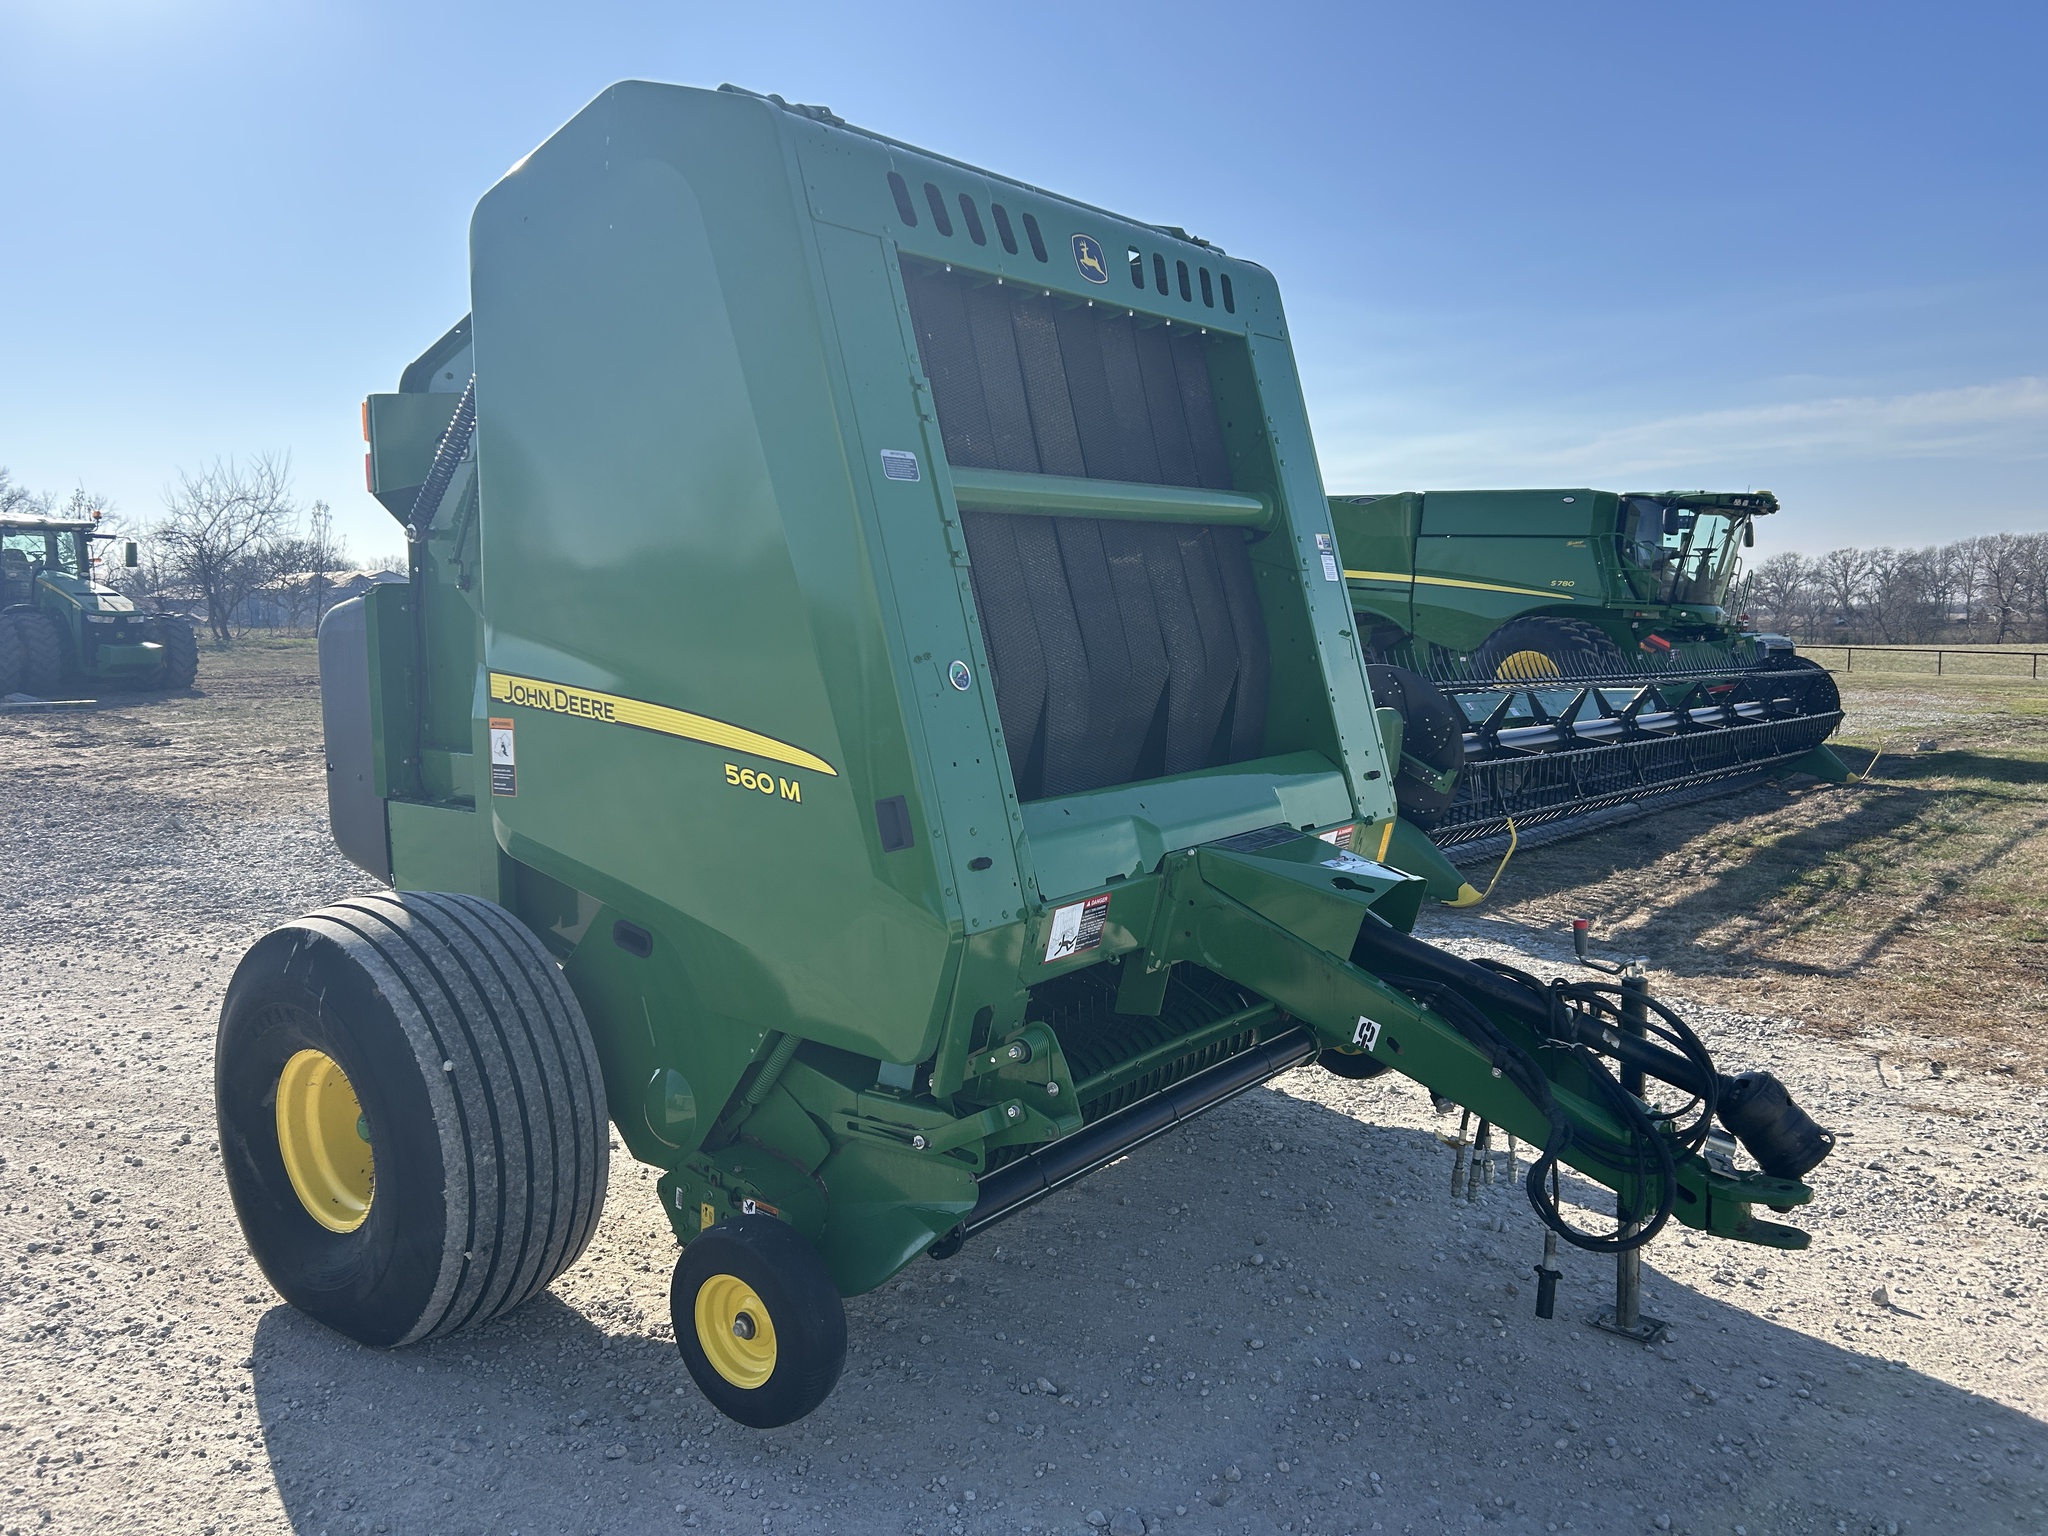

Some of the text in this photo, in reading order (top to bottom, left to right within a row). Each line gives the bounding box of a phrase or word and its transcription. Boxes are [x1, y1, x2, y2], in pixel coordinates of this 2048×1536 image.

[504, 681, 615, 720] JOHN DEERE
[724, 762, 802, 803] 560 M
[1091, 896, 1108, 906] DANGER
